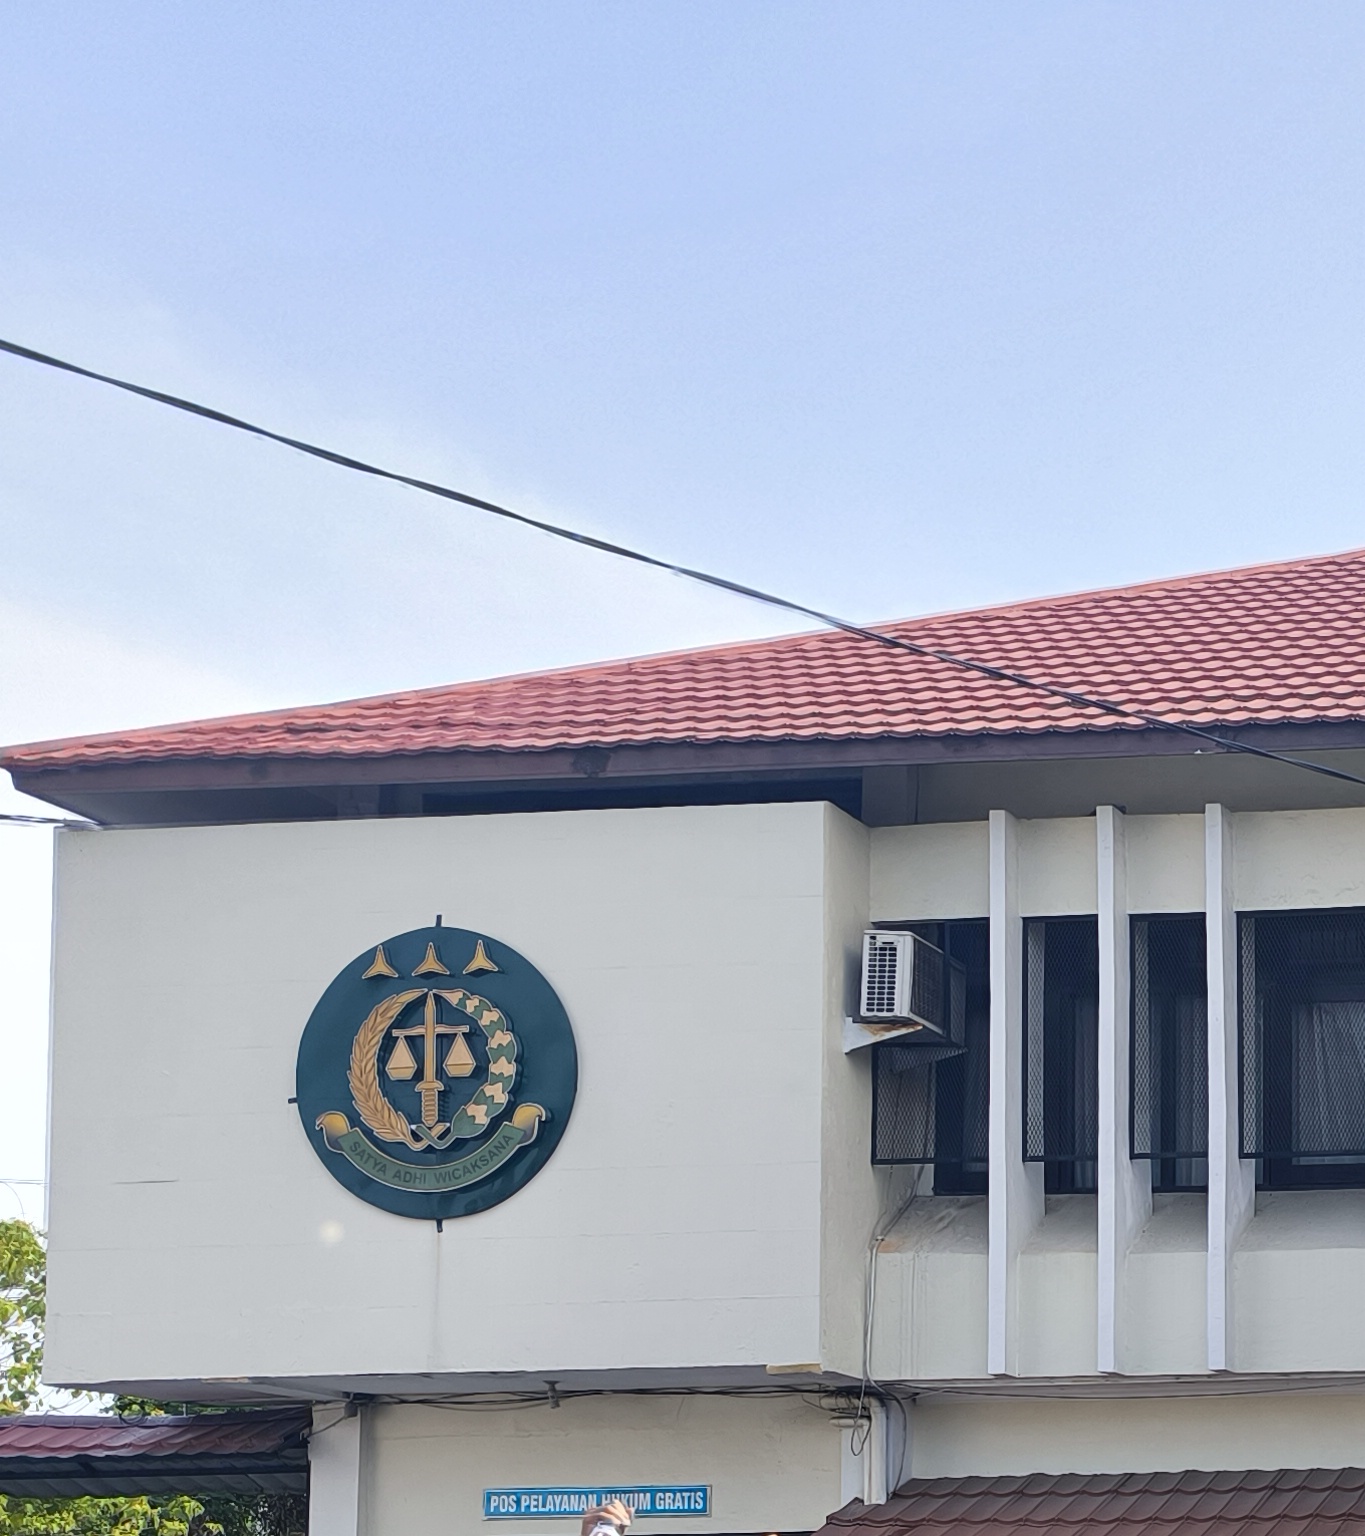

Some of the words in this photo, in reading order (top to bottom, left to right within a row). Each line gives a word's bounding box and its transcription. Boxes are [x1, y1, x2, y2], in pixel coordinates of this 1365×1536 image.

[349, 1141, 387, 1176] SATYA
[392, 1170, 426, 1185] ADHI
[433, 1132, 515, 1184] WICAKSANA
[490, 1494, 517, 1513] POS
[520, 1493, 597, 1513] PELAYANAN
[655, 1491, 704, 1510] GRATIS
